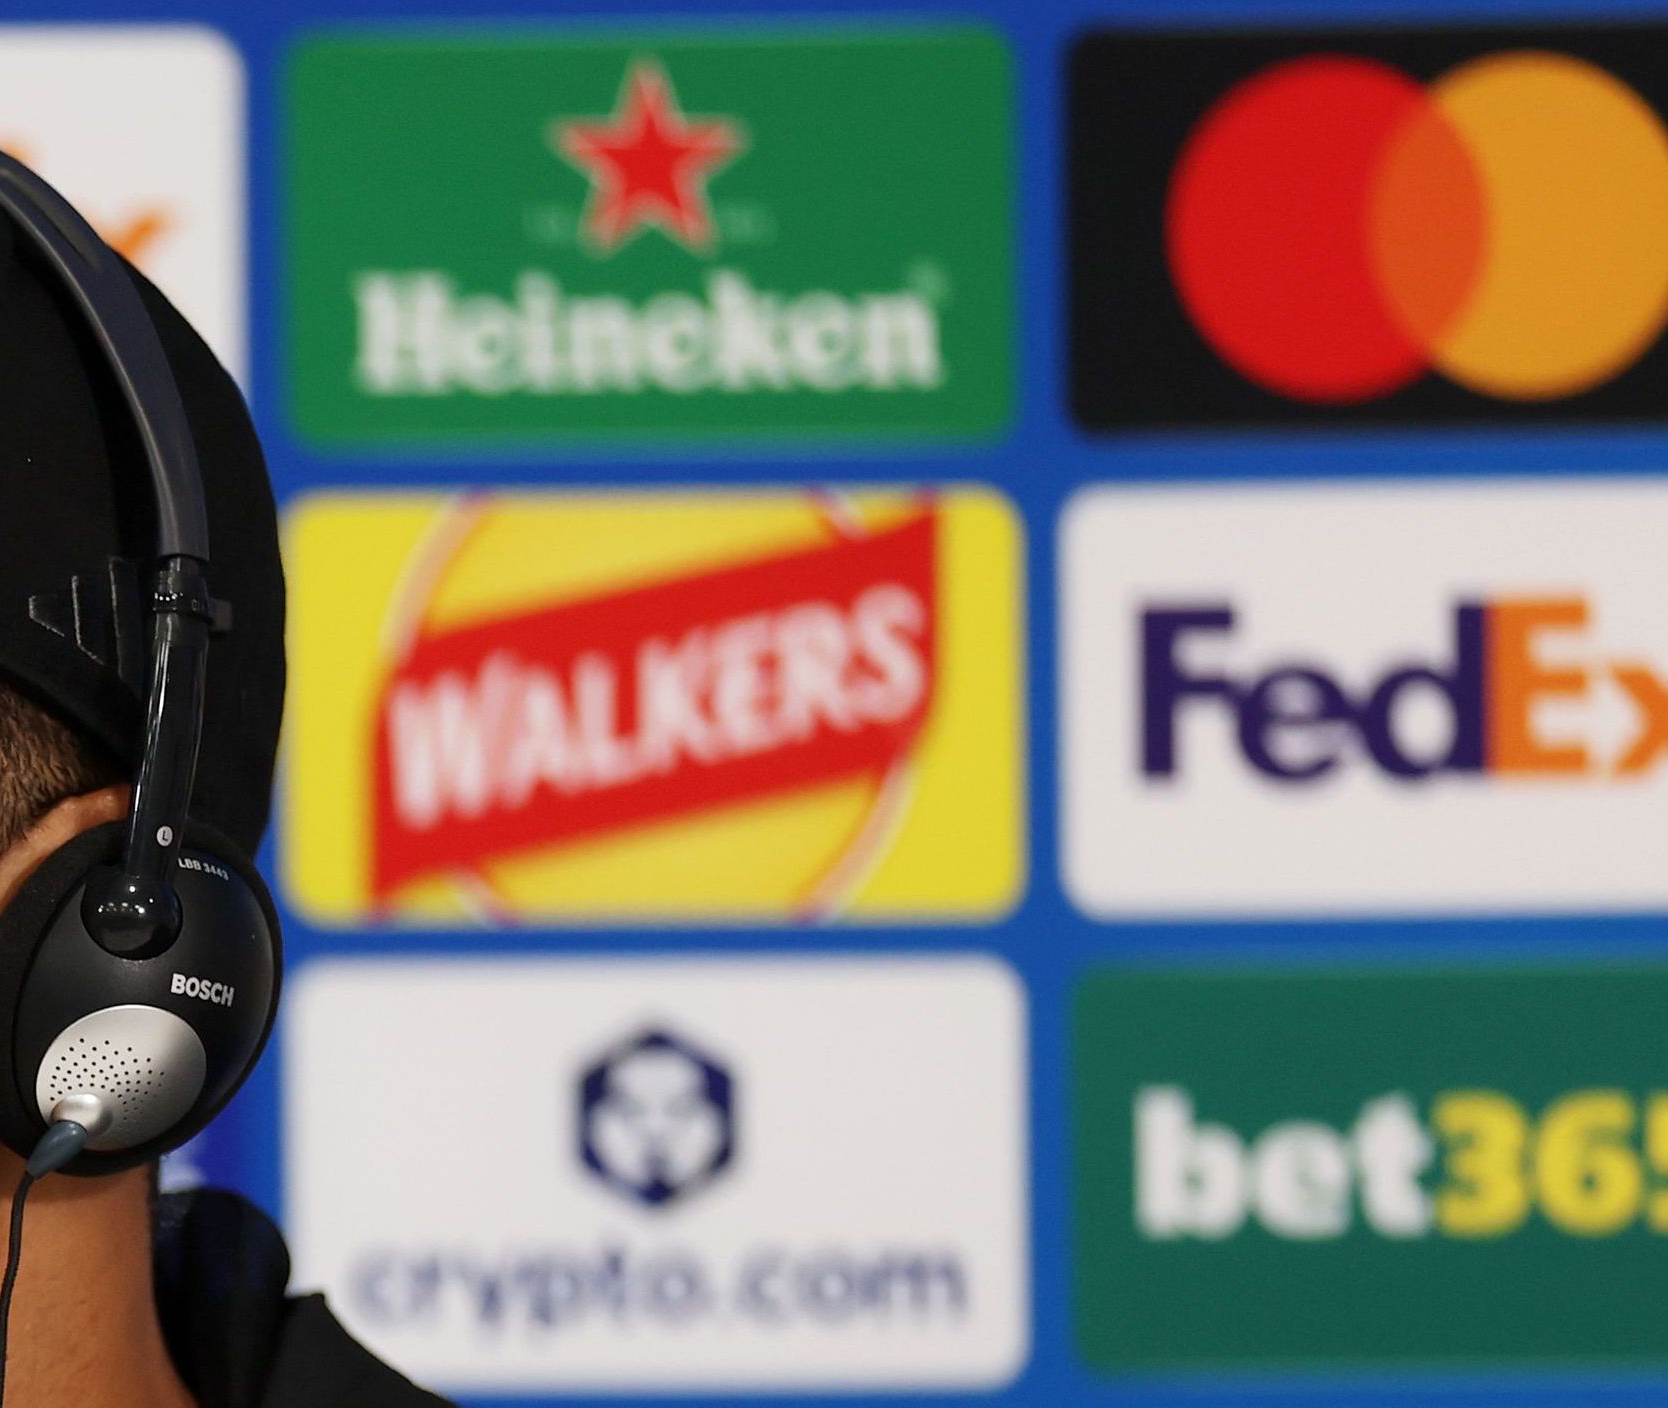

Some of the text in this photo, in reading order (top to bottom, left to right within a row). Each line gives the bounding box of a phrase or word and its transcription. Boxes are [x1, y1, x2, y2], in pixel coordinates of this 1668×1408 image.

[356, 268, 945, 394] Heineken
[386, 585, 930, 827] WALKERS
[178, 857, 202, 871] LBB
[171, 973, 235, 1007] BOSCH
[1134, 1086, 1668, 1238] bet36
[351, 1243, 971, 1329] crypto.com
